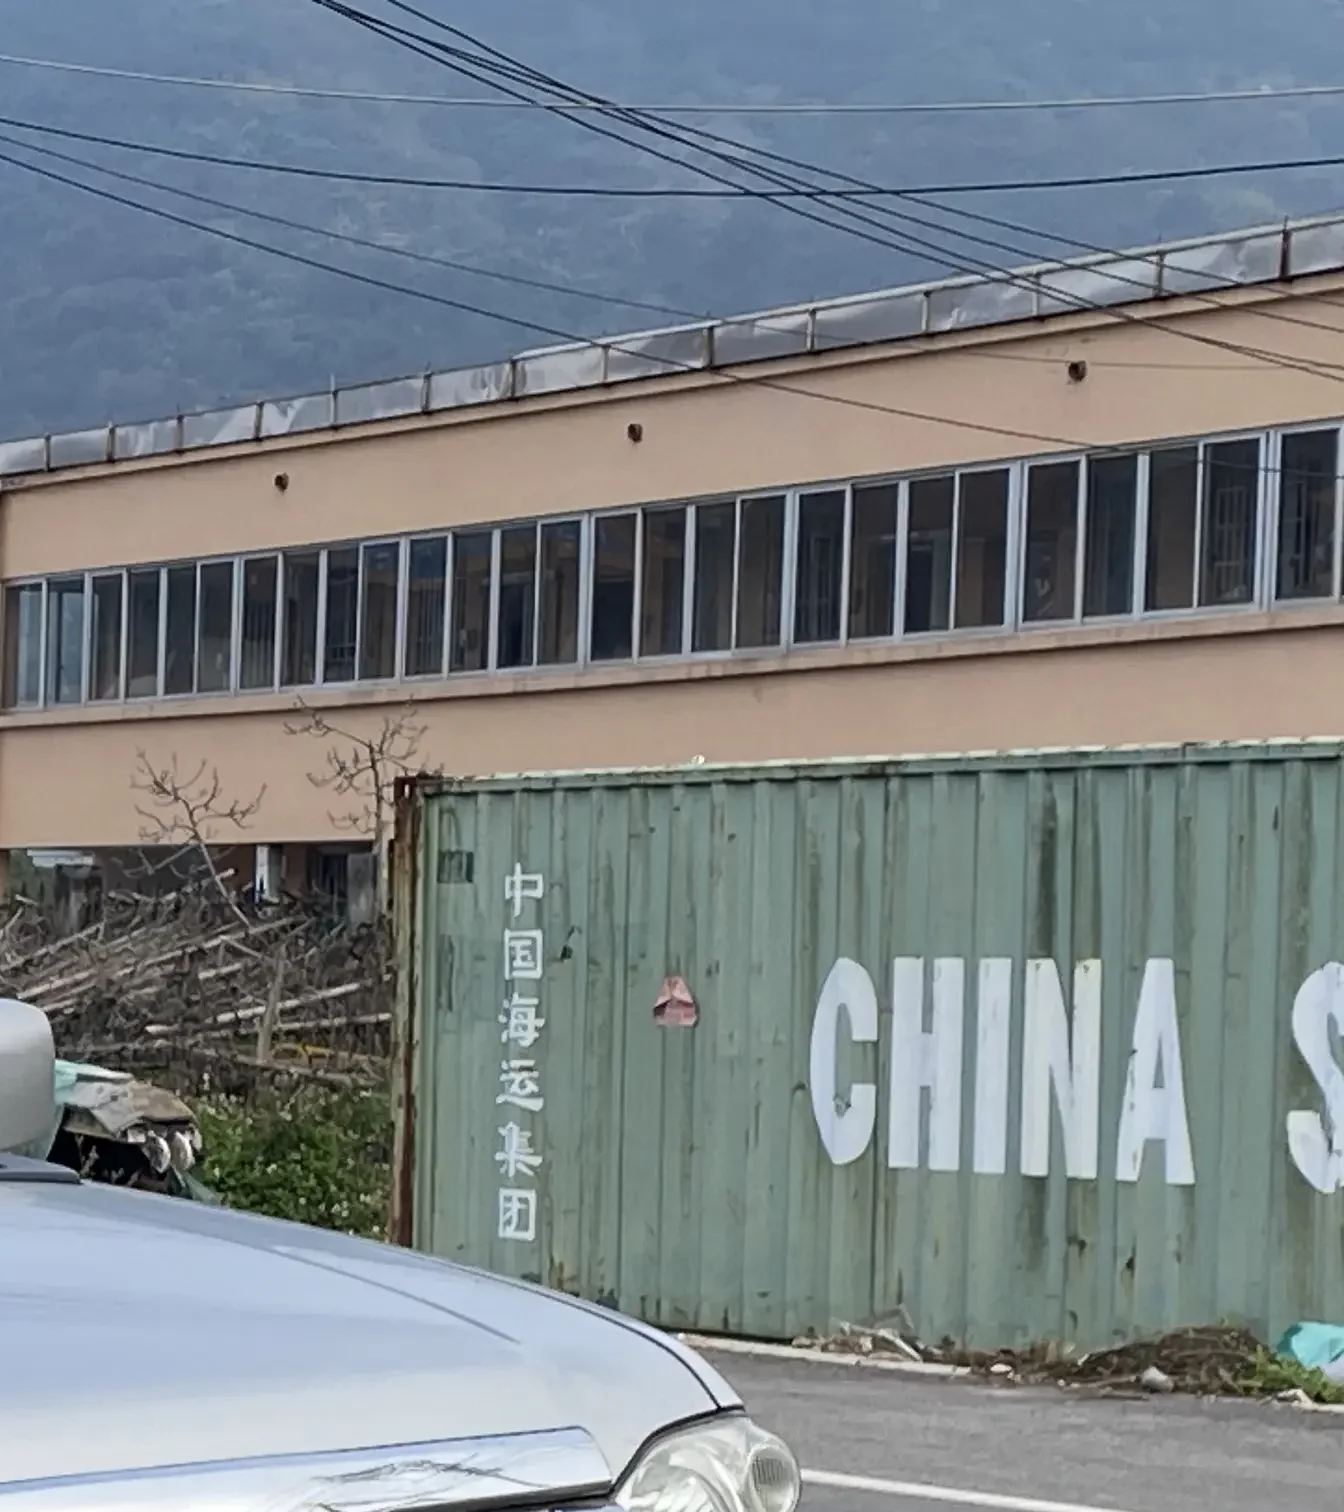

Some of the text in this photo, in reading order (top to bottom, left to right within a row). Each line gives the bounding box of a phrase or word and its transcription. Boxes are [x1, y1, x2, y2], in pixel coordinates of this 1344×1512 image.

[494, 861, 547, 1242] 中国海运集团
[810, 956, 1196, 1186] CHINA
